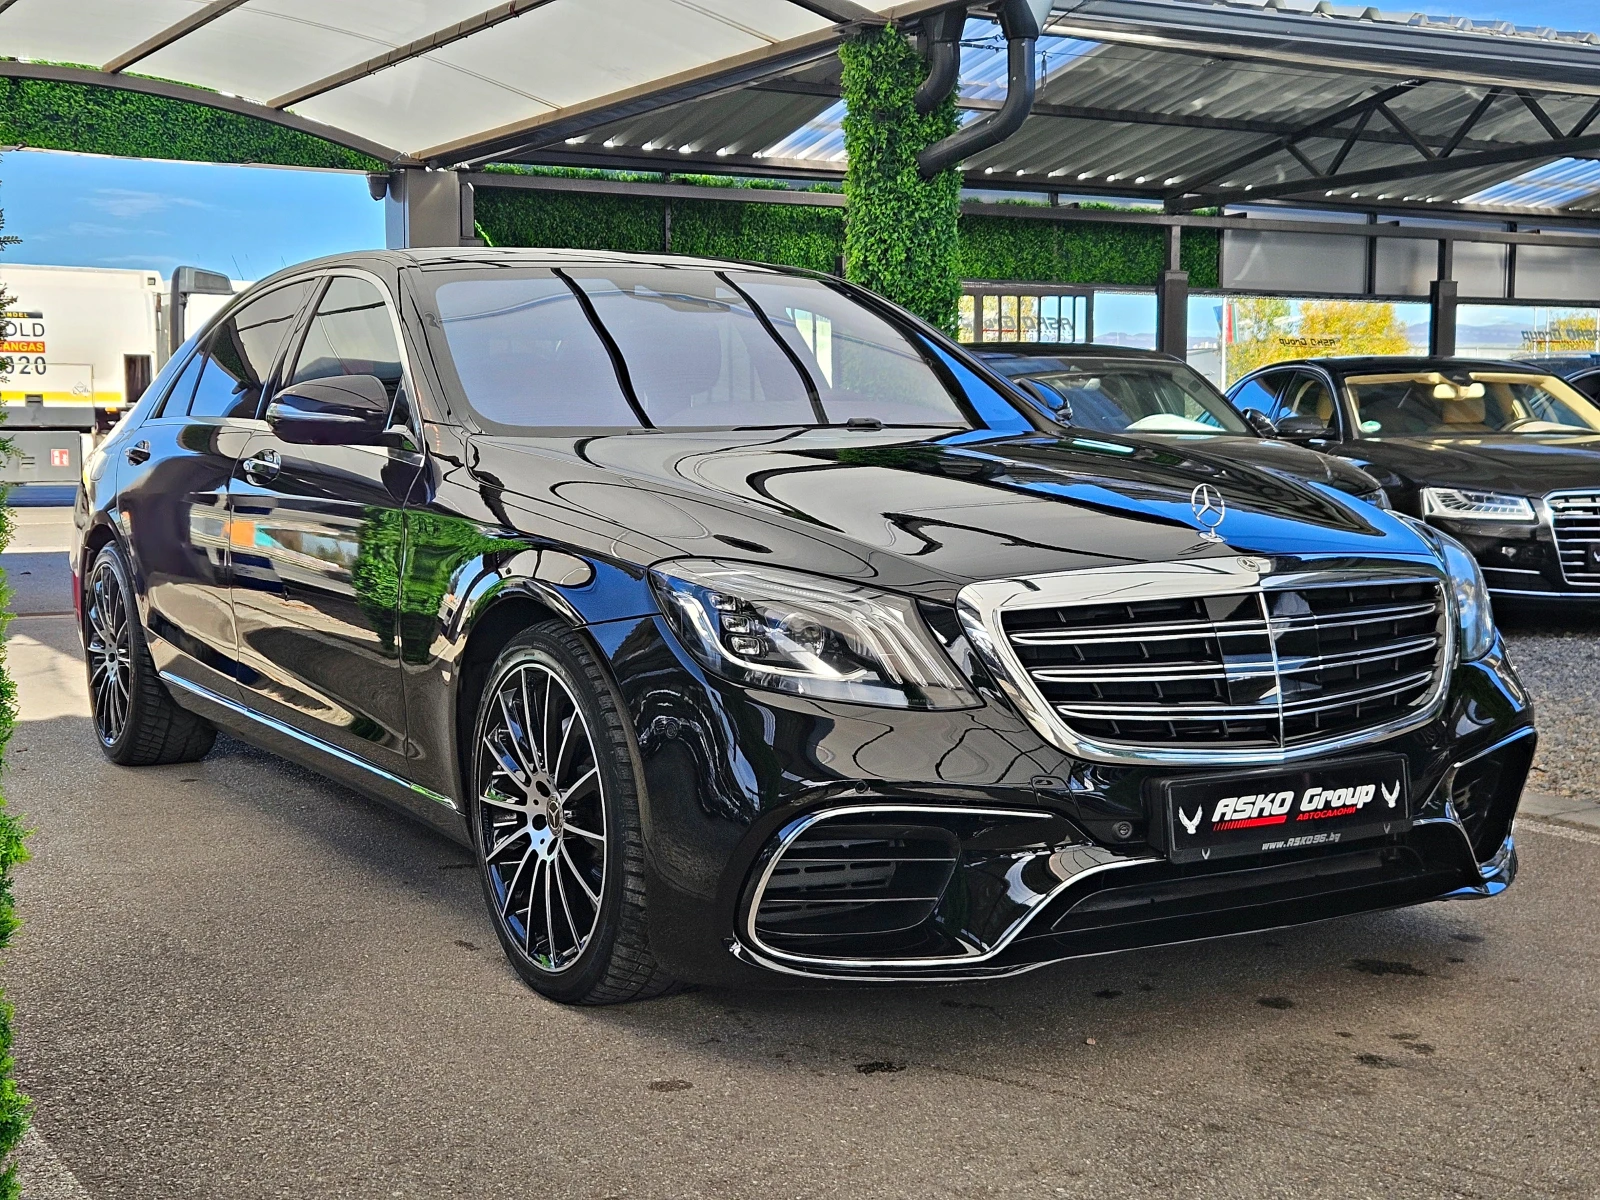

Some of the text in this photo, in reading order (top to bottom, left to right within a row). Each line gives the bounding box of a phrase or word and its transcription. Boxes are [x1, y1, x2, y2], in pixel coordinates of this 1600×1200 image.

[0, 342, 44, 351] ANGAS
[1212, 784, 1376, 822] ASKO Group
[1296, 806, 1357, 821] АВТОСАЛОНИ
[1261, 832, 1341, 850] www.ASKO96.bg
